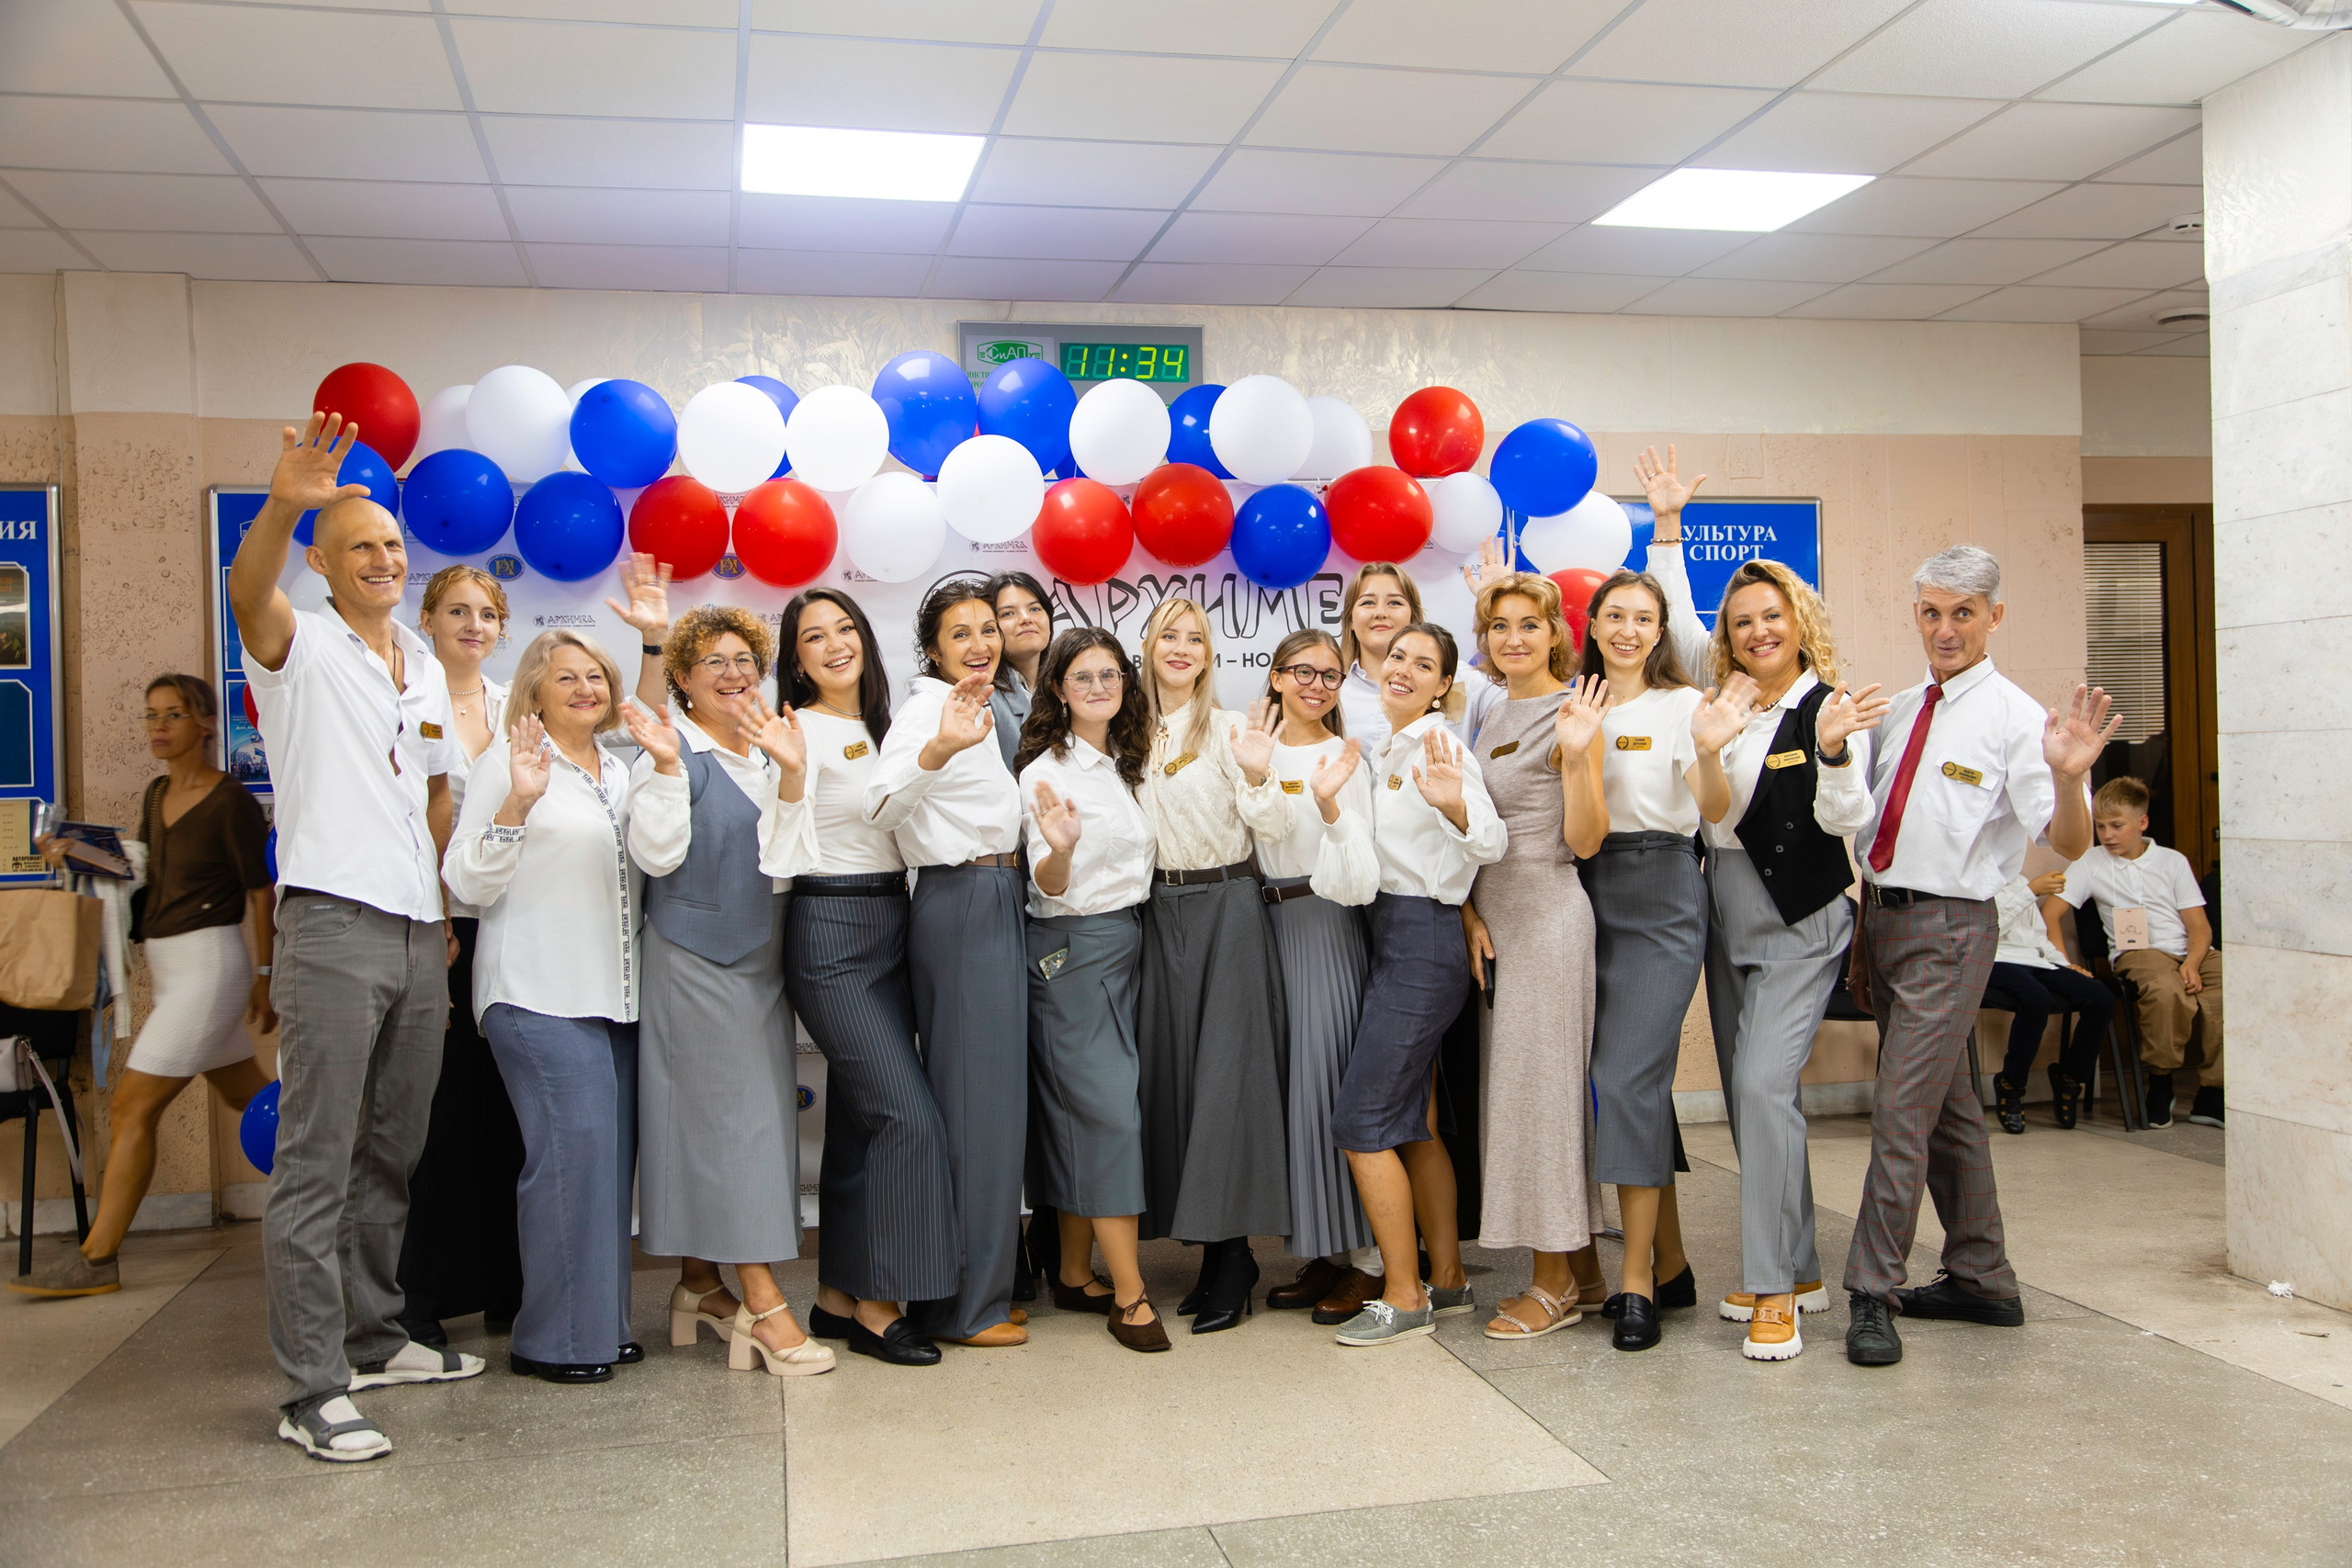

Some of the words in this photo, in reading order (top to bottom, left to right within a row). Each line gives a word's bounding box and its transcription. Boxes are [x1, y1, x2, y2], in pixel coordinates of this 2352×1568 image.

[1080, 346, 1183, 379] 11:34
[1680, 525, 1778, 542] УЛЬТУРА
[1689, 544, 1764, 561] СПОРТ
[1052, 573, 1344, 639] АРХИМЕ
[1242, 652, 1275, 668] НО
